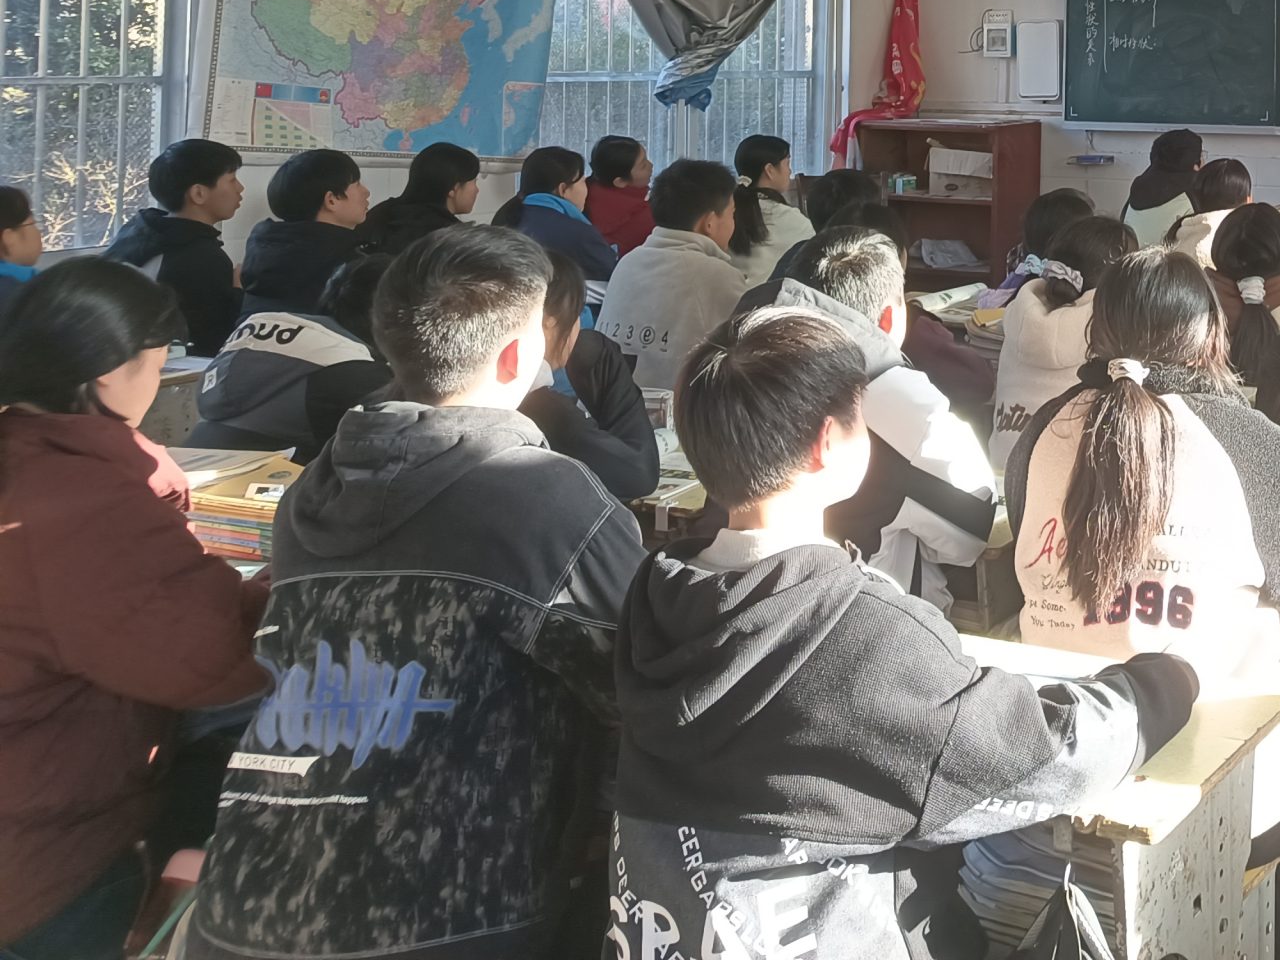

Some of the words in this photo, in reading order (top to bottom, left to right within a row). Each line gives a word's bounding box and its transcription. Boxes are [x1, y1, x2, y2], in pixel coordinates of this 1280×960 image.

[626, 325, 634, 339] 3
[661, 330, 669, 344] 4
[238, 755, 267, 769] YORK
[270, 758, 297, 771] CITY
